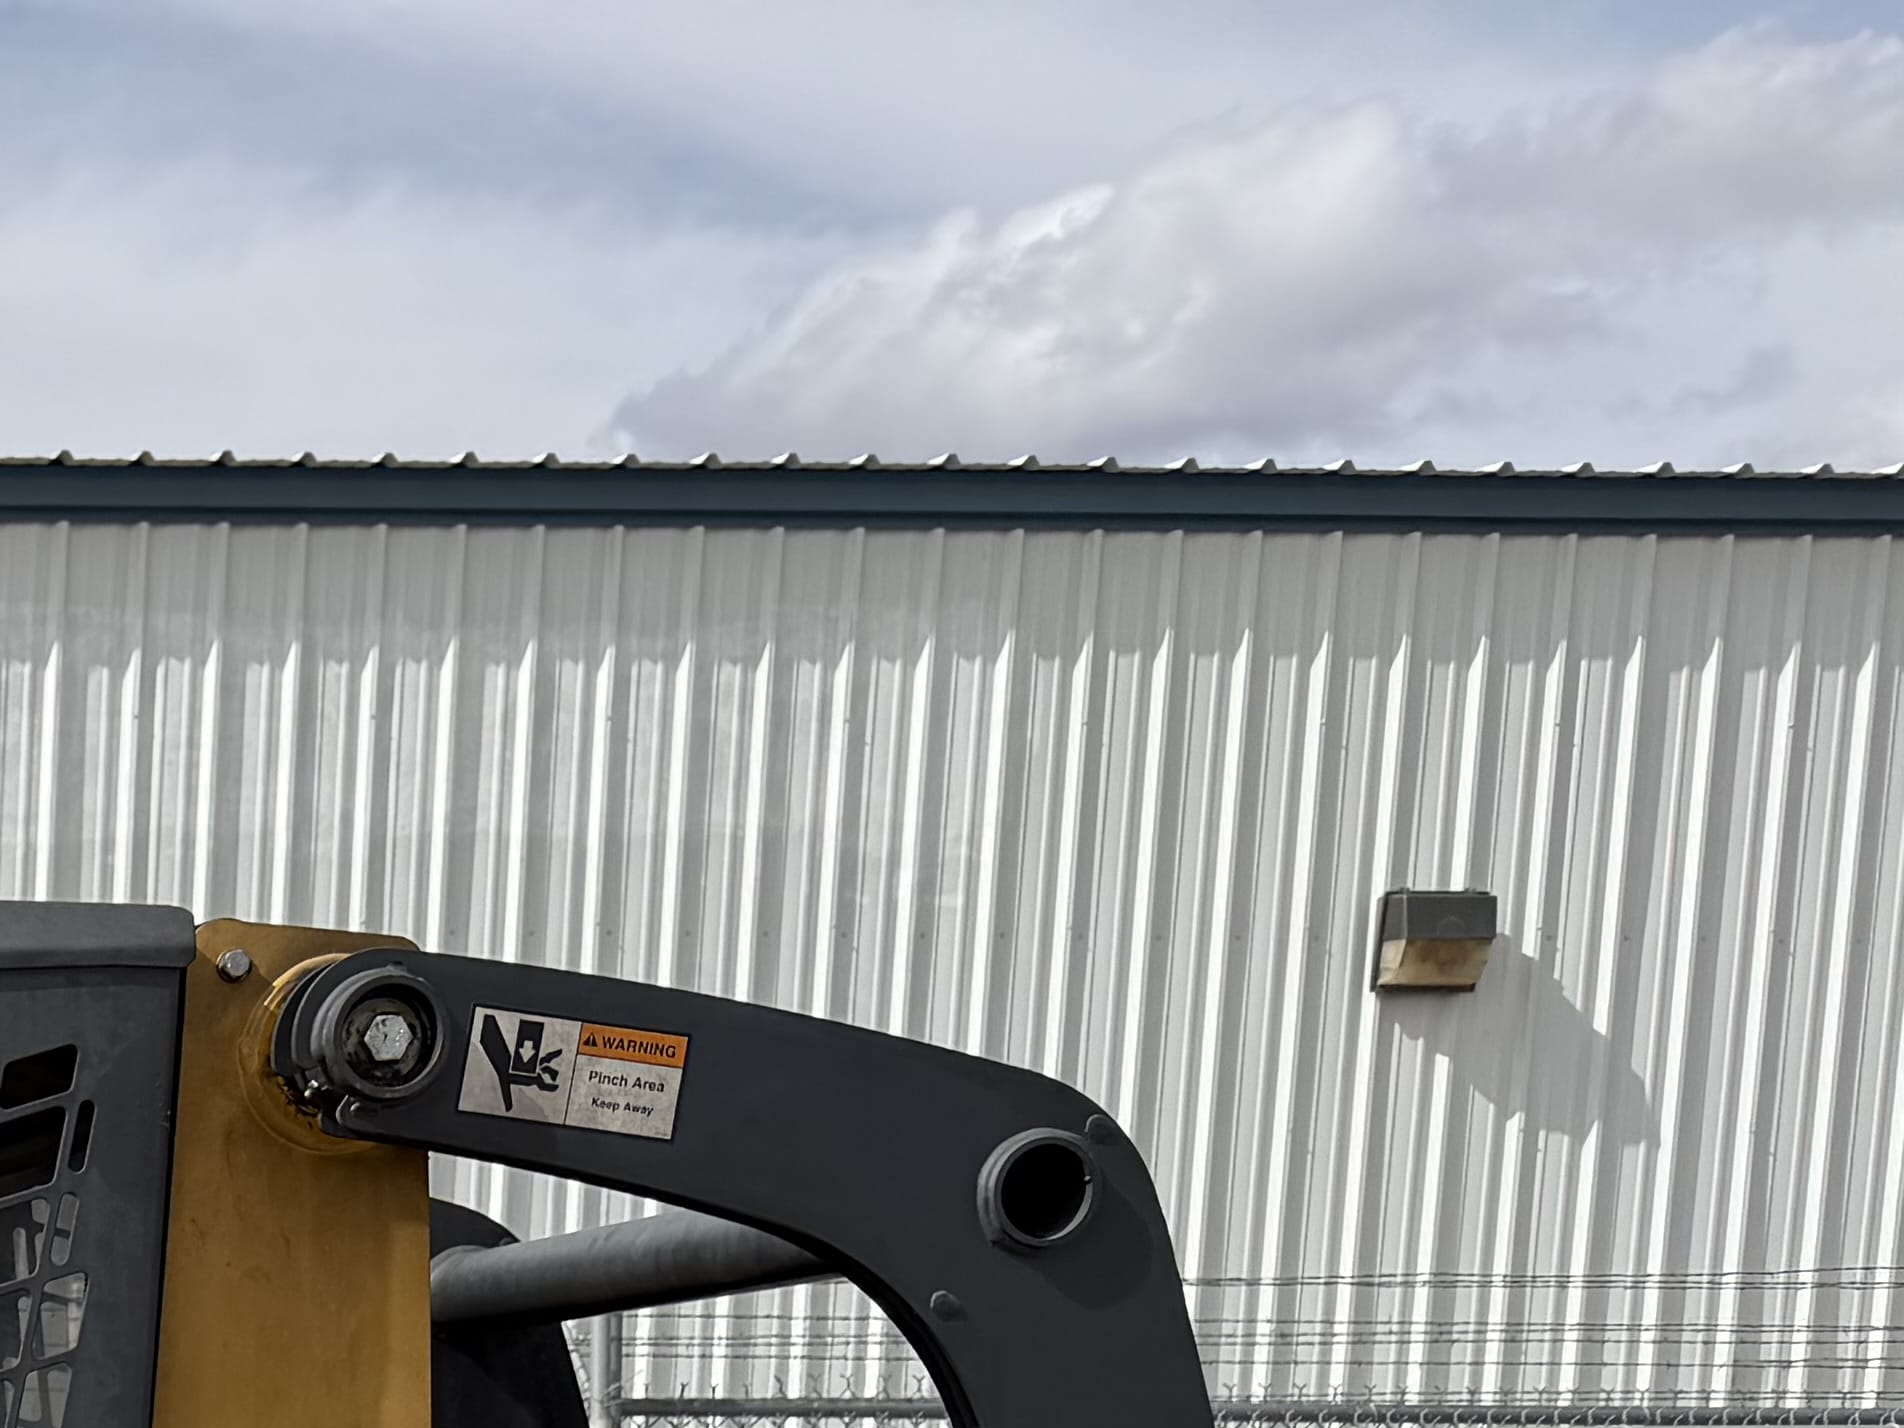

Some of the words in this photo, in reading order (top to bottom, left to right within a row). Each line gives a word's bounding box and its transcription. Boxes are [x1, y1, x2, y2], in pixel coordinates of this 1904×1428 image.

[602, 1036, 676, 1058] WARNING
[588, 1069, 628, 1087] Pinch
[632, 1075, 666, 1093] Area
[591, 1096, 620, 1113] Keep
[623, 1102, 654, 1118] Away
